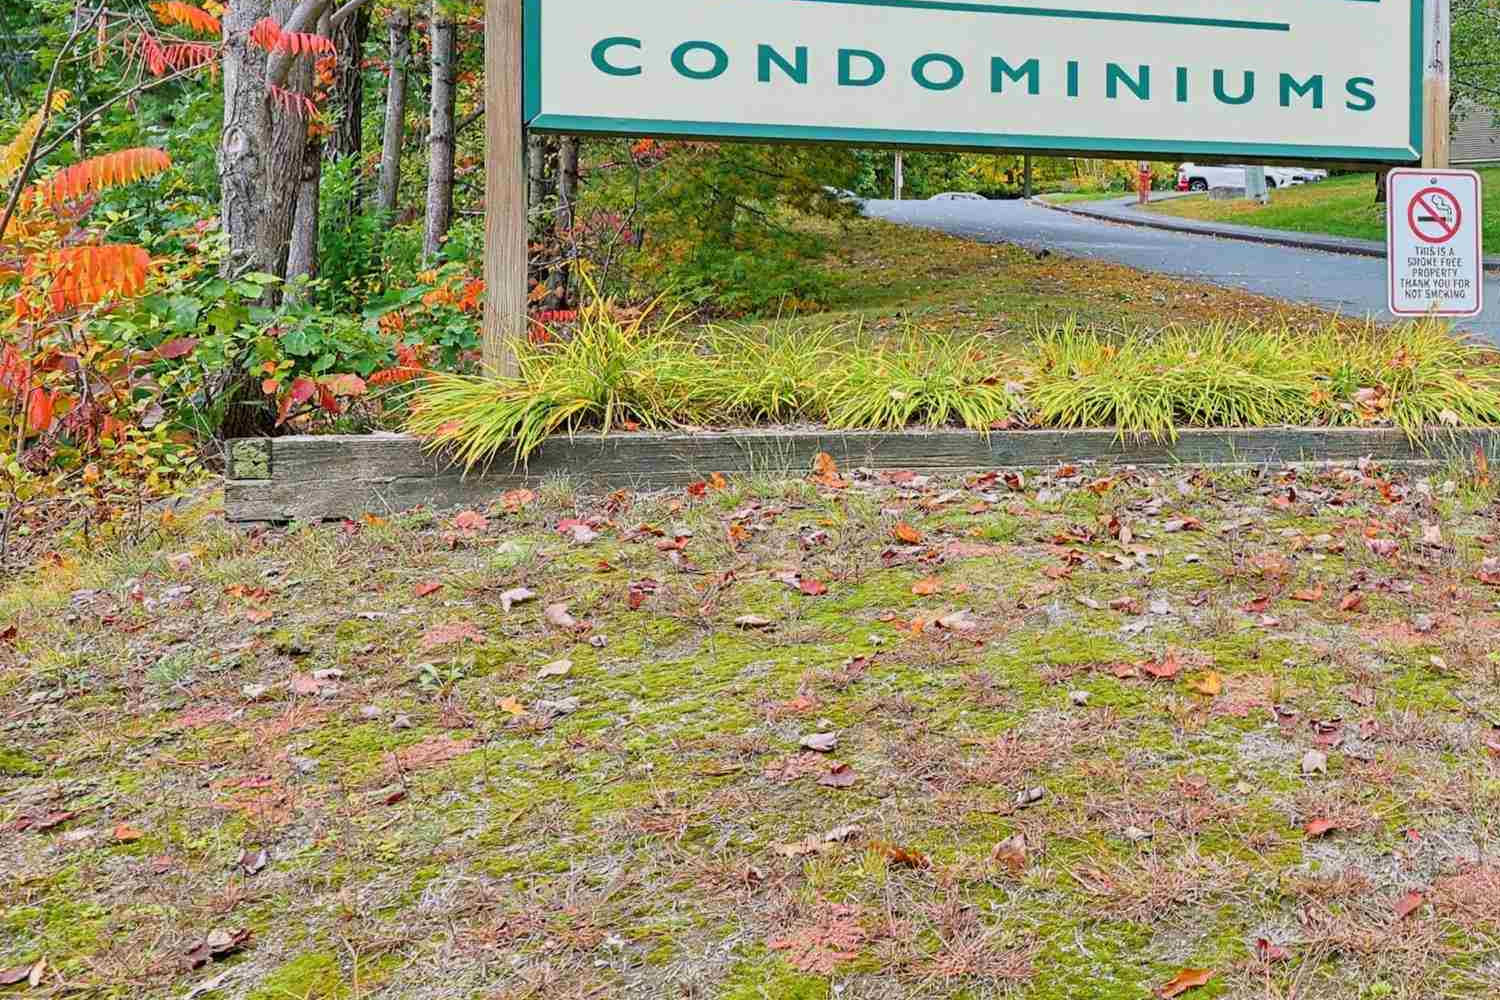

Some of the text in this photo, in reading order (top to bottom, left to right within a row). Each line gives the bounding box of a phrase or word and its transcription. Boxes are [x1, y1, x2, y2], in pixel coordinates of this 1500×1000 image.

[590, 36, 1377, 112] CONDOMINIUMS
[1415, 246, 1455, 256] THIS IS A
[1408, 257, 1464, 267] SMOKE FREE
[1412, 268, 1458, 278] PROPERTY
[1400, 278, 1471, 288] THANK YOU FOR
[1405, 289, 1465, 299] NOT SMOKING
